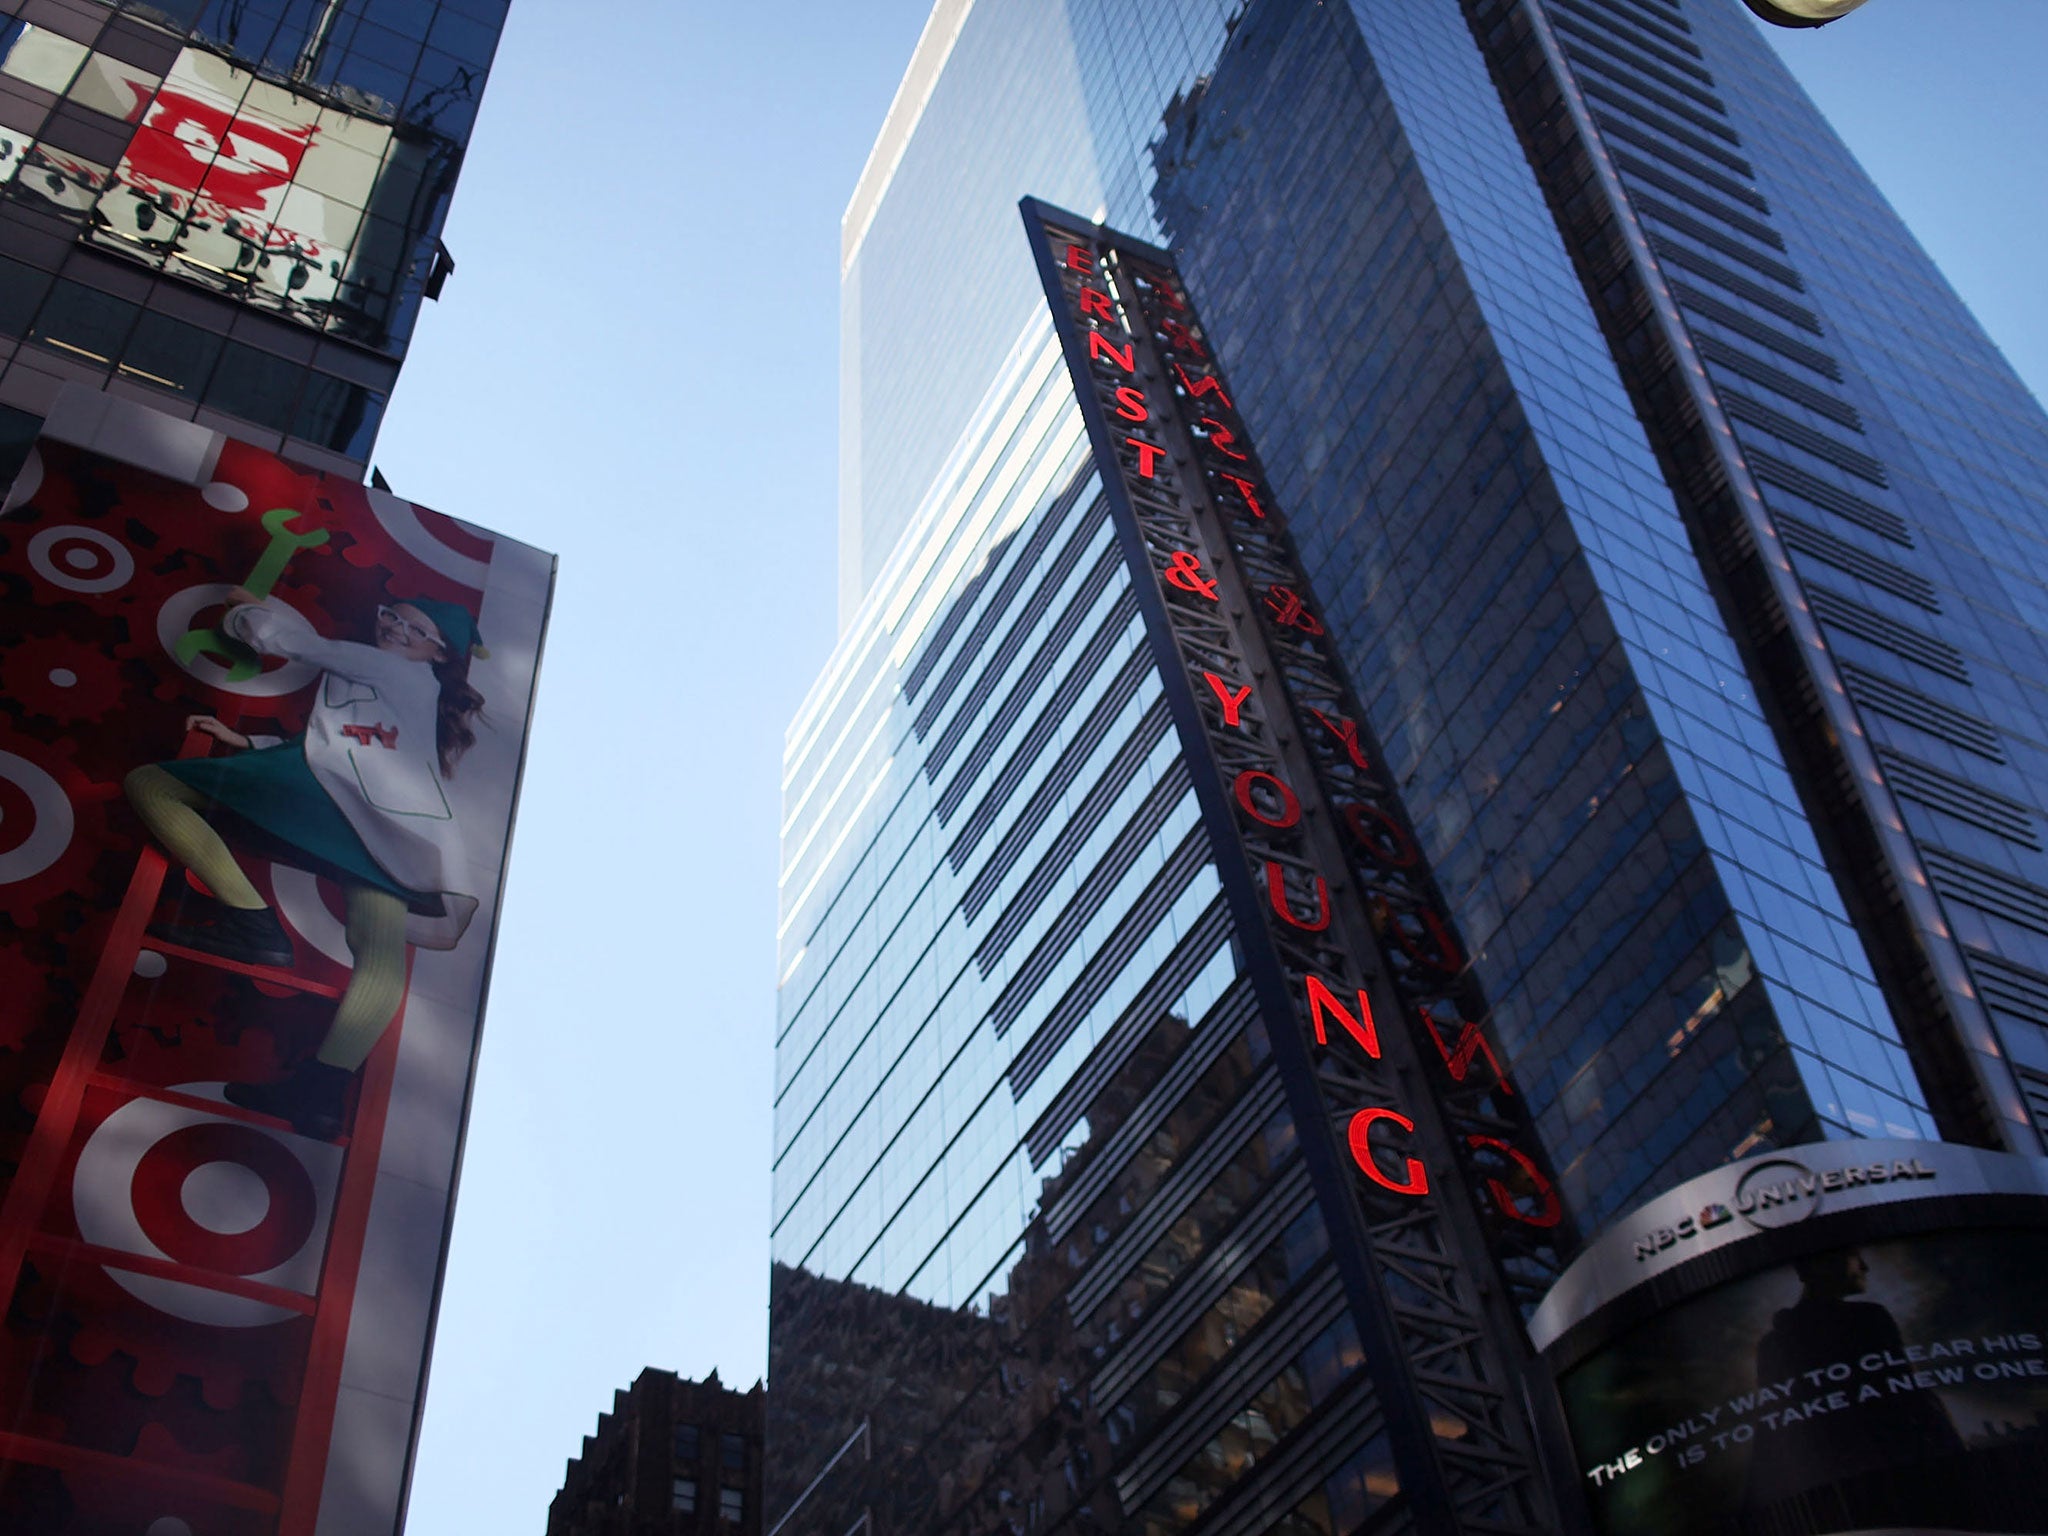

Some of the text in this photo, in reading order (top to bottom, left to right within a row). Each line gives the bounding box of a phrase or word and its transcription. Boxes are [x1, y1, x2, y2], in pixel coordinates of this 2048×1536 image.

[1065, 244, 1429, 1196] ERNST & YOUNG
[1633, 1158, 1936, 1261] NBC UNIVERSAL
[1586, 1332, 2044, 1487] THE ONLY WAY TO CLEAR HIS
[1676, 1358, 2048, 1470] IS TO TAKE A NEW ONE
